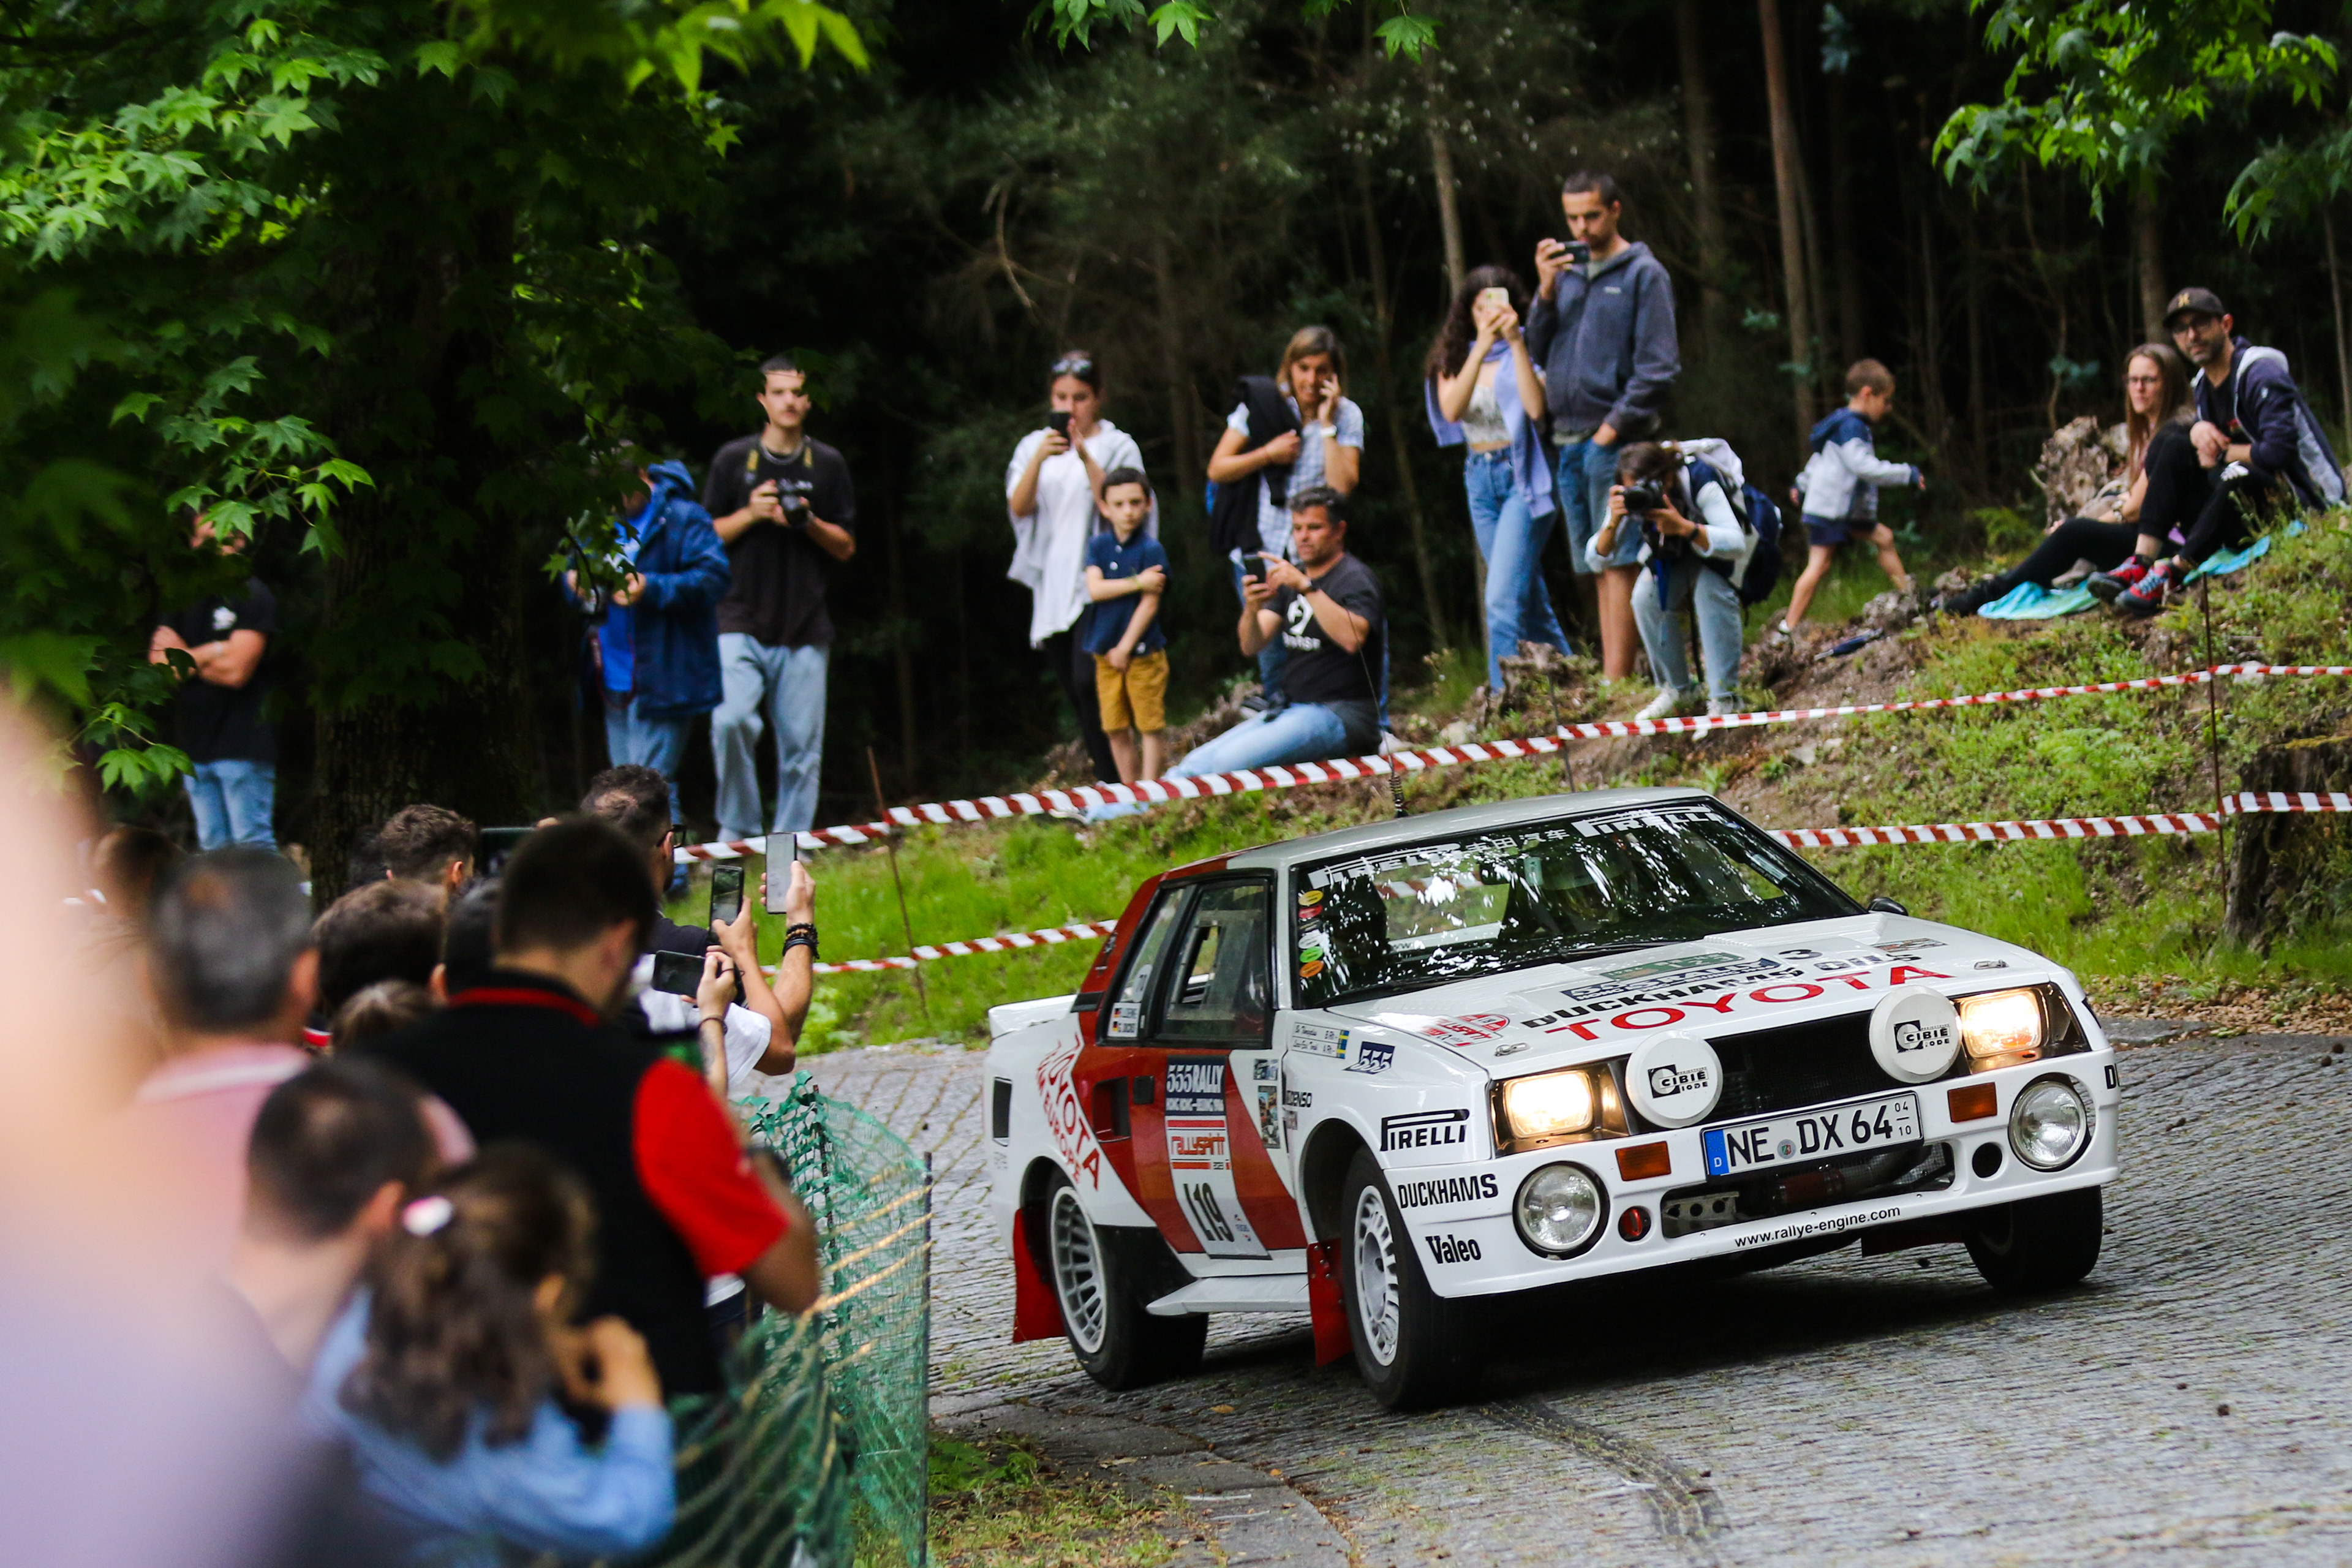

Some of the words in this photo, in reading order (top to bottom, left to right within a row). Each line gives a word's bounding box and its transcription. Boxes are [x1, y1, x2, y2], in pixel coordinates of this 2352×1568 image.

[1544, 965, 1958, 1041] TOYOTA
[1925, 1038, 1950, 1047] ODE
[1349, 1049, 1392, 1072] 555
[1681, 1082, 1708, 1091] IODE
[1894, 1101, 1909, 1112] 04
[1379, 1109, 1470, 1152] PIRELLI
[1726, 1126, 1775, 1167] NE
[1796, 1114, 1844, 1155] DX
[1851, 1105, 1893, 1144] 64
[1898, 1125, 1912, 1137] 10
[1713, 1156, 1722, 1167] D
[1398, 1174, 1499, 1209] DUCKHAMS
[1735, 1207, 1901, 1248] www.rallye-engine.com
[1425, 1234, 1482, 1264] Valeo
